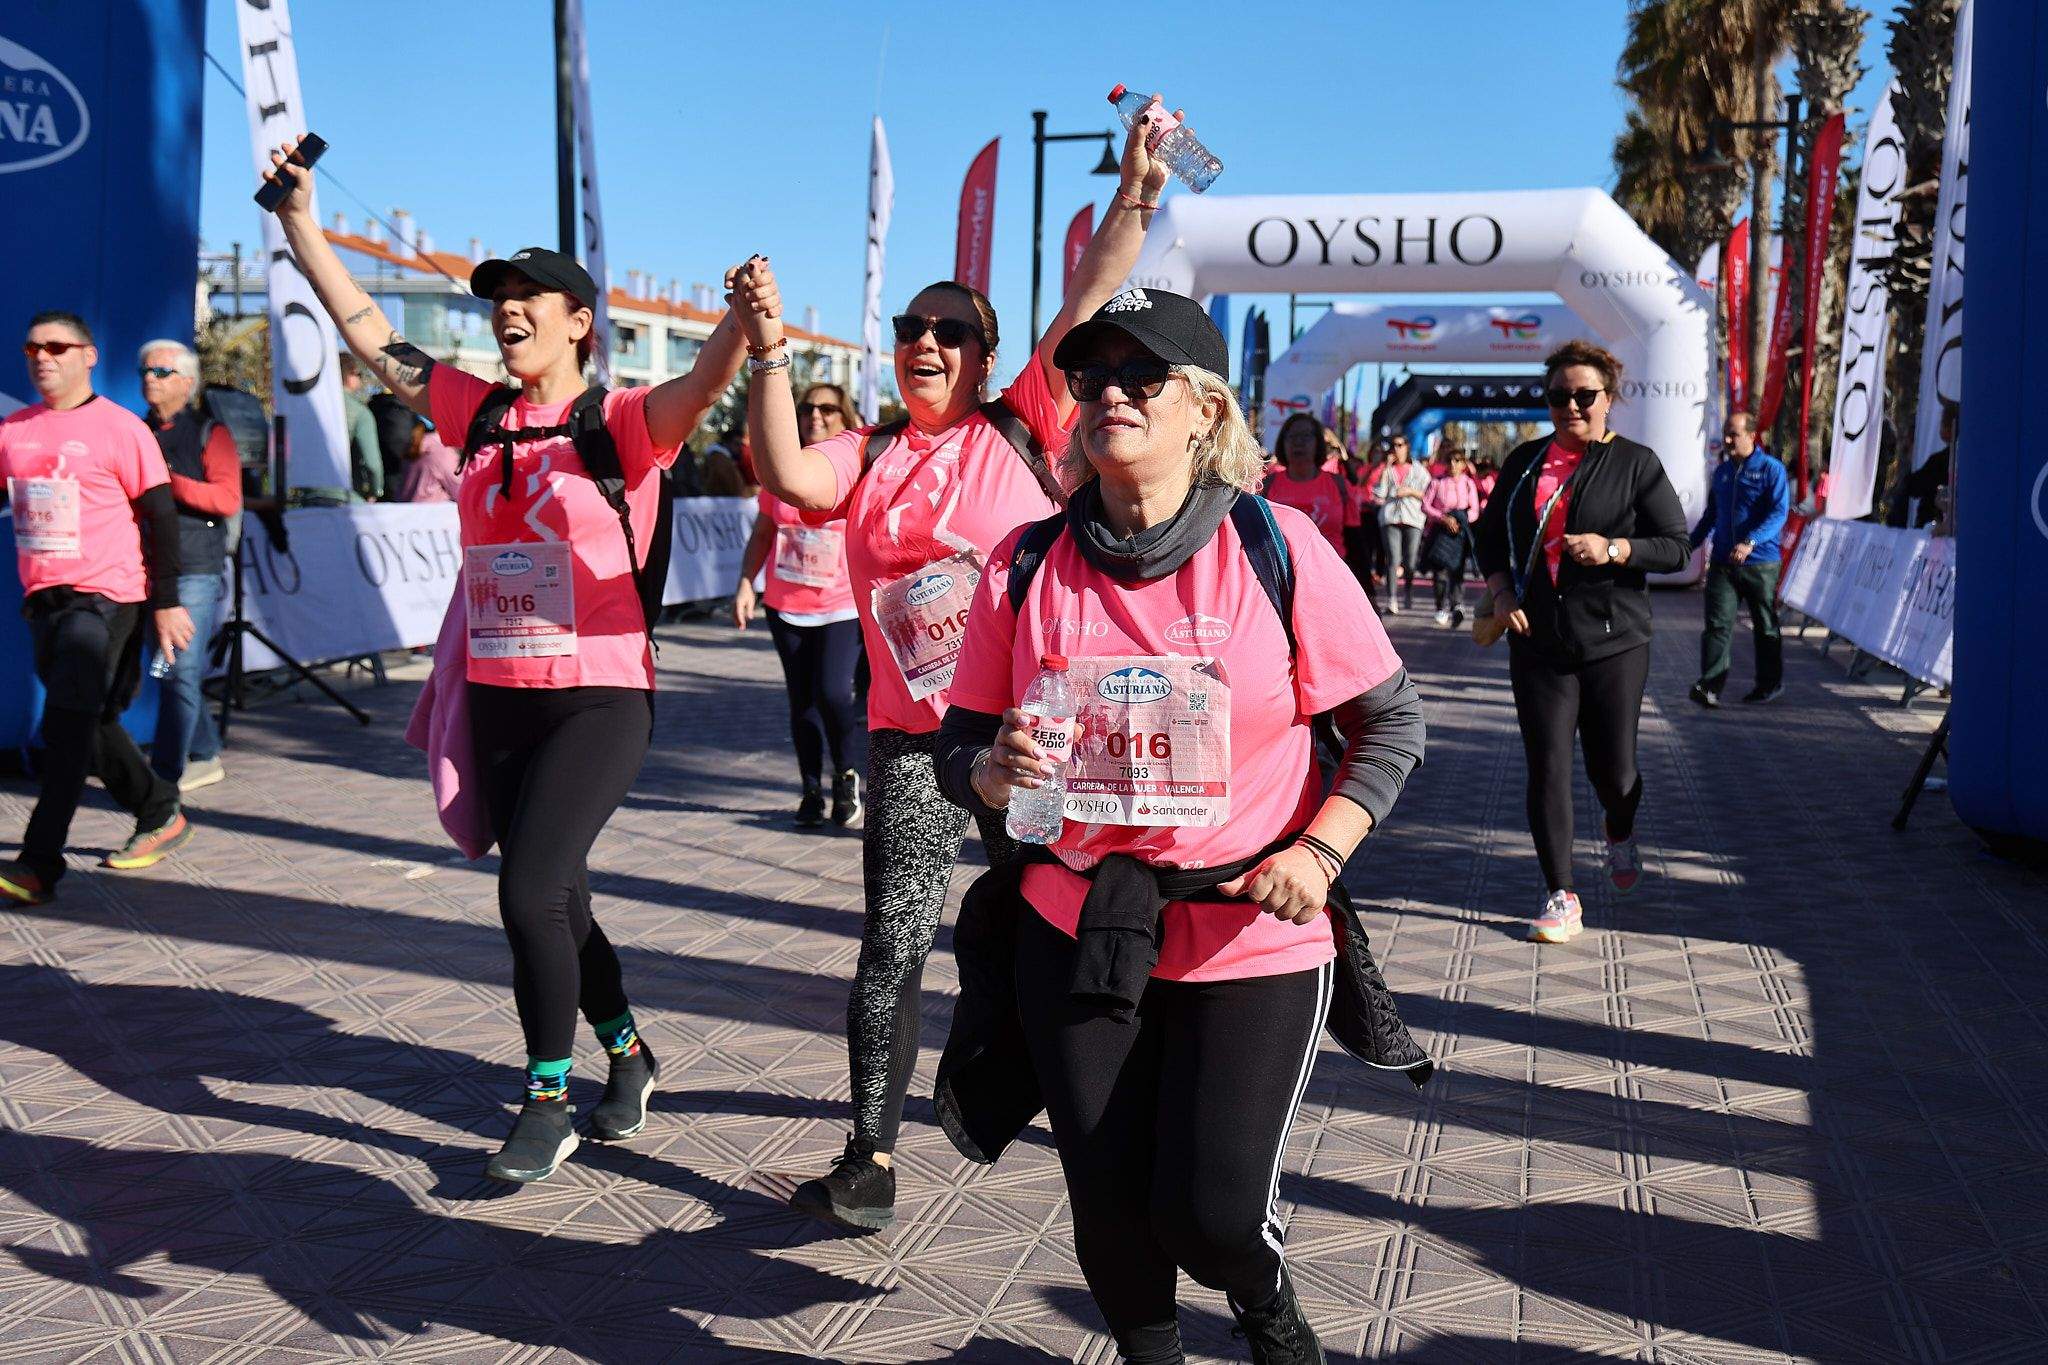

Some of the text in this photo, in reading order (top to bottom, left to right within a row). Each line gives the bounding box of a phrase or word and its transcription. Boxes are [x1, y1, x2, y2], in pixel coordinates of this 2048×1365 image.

[1248, 213, 1503, 268] OYSHO
[1579, 270, 1661, 289] OYSHO
[1433, 384, 1544, 398] VOLVO
[1621, 380, 1696, 399] OYSHO
[355, 528, 462, 588] OYSH
[909, 579, 951, 603] ASTURIANA
[497, 594, 535, 613] 016
[927, 608, 969, 642] 016
[1171, 627, 1227, 638] ASTURIANA
[945, 638, 963, 651] 731
[917, 660, 942, 675] CARRERA
[942, 655, 951, 664] DE
[1102, 680, 1167, 695] ASTURIANA
[1031, 729, 1066, 740] ZERO
[1031, 738, 1065, 749] ODIO
[1106, 732, 1172, 759] 016
[1120, 767, 1149, 779] 7093
[1072, 781, 1205, 793] CARRERA DE LA MUJER VALENCIA
[1066, 799, 1118, 814] OYSHO
[1152, 805, 1208, 816] Santander
